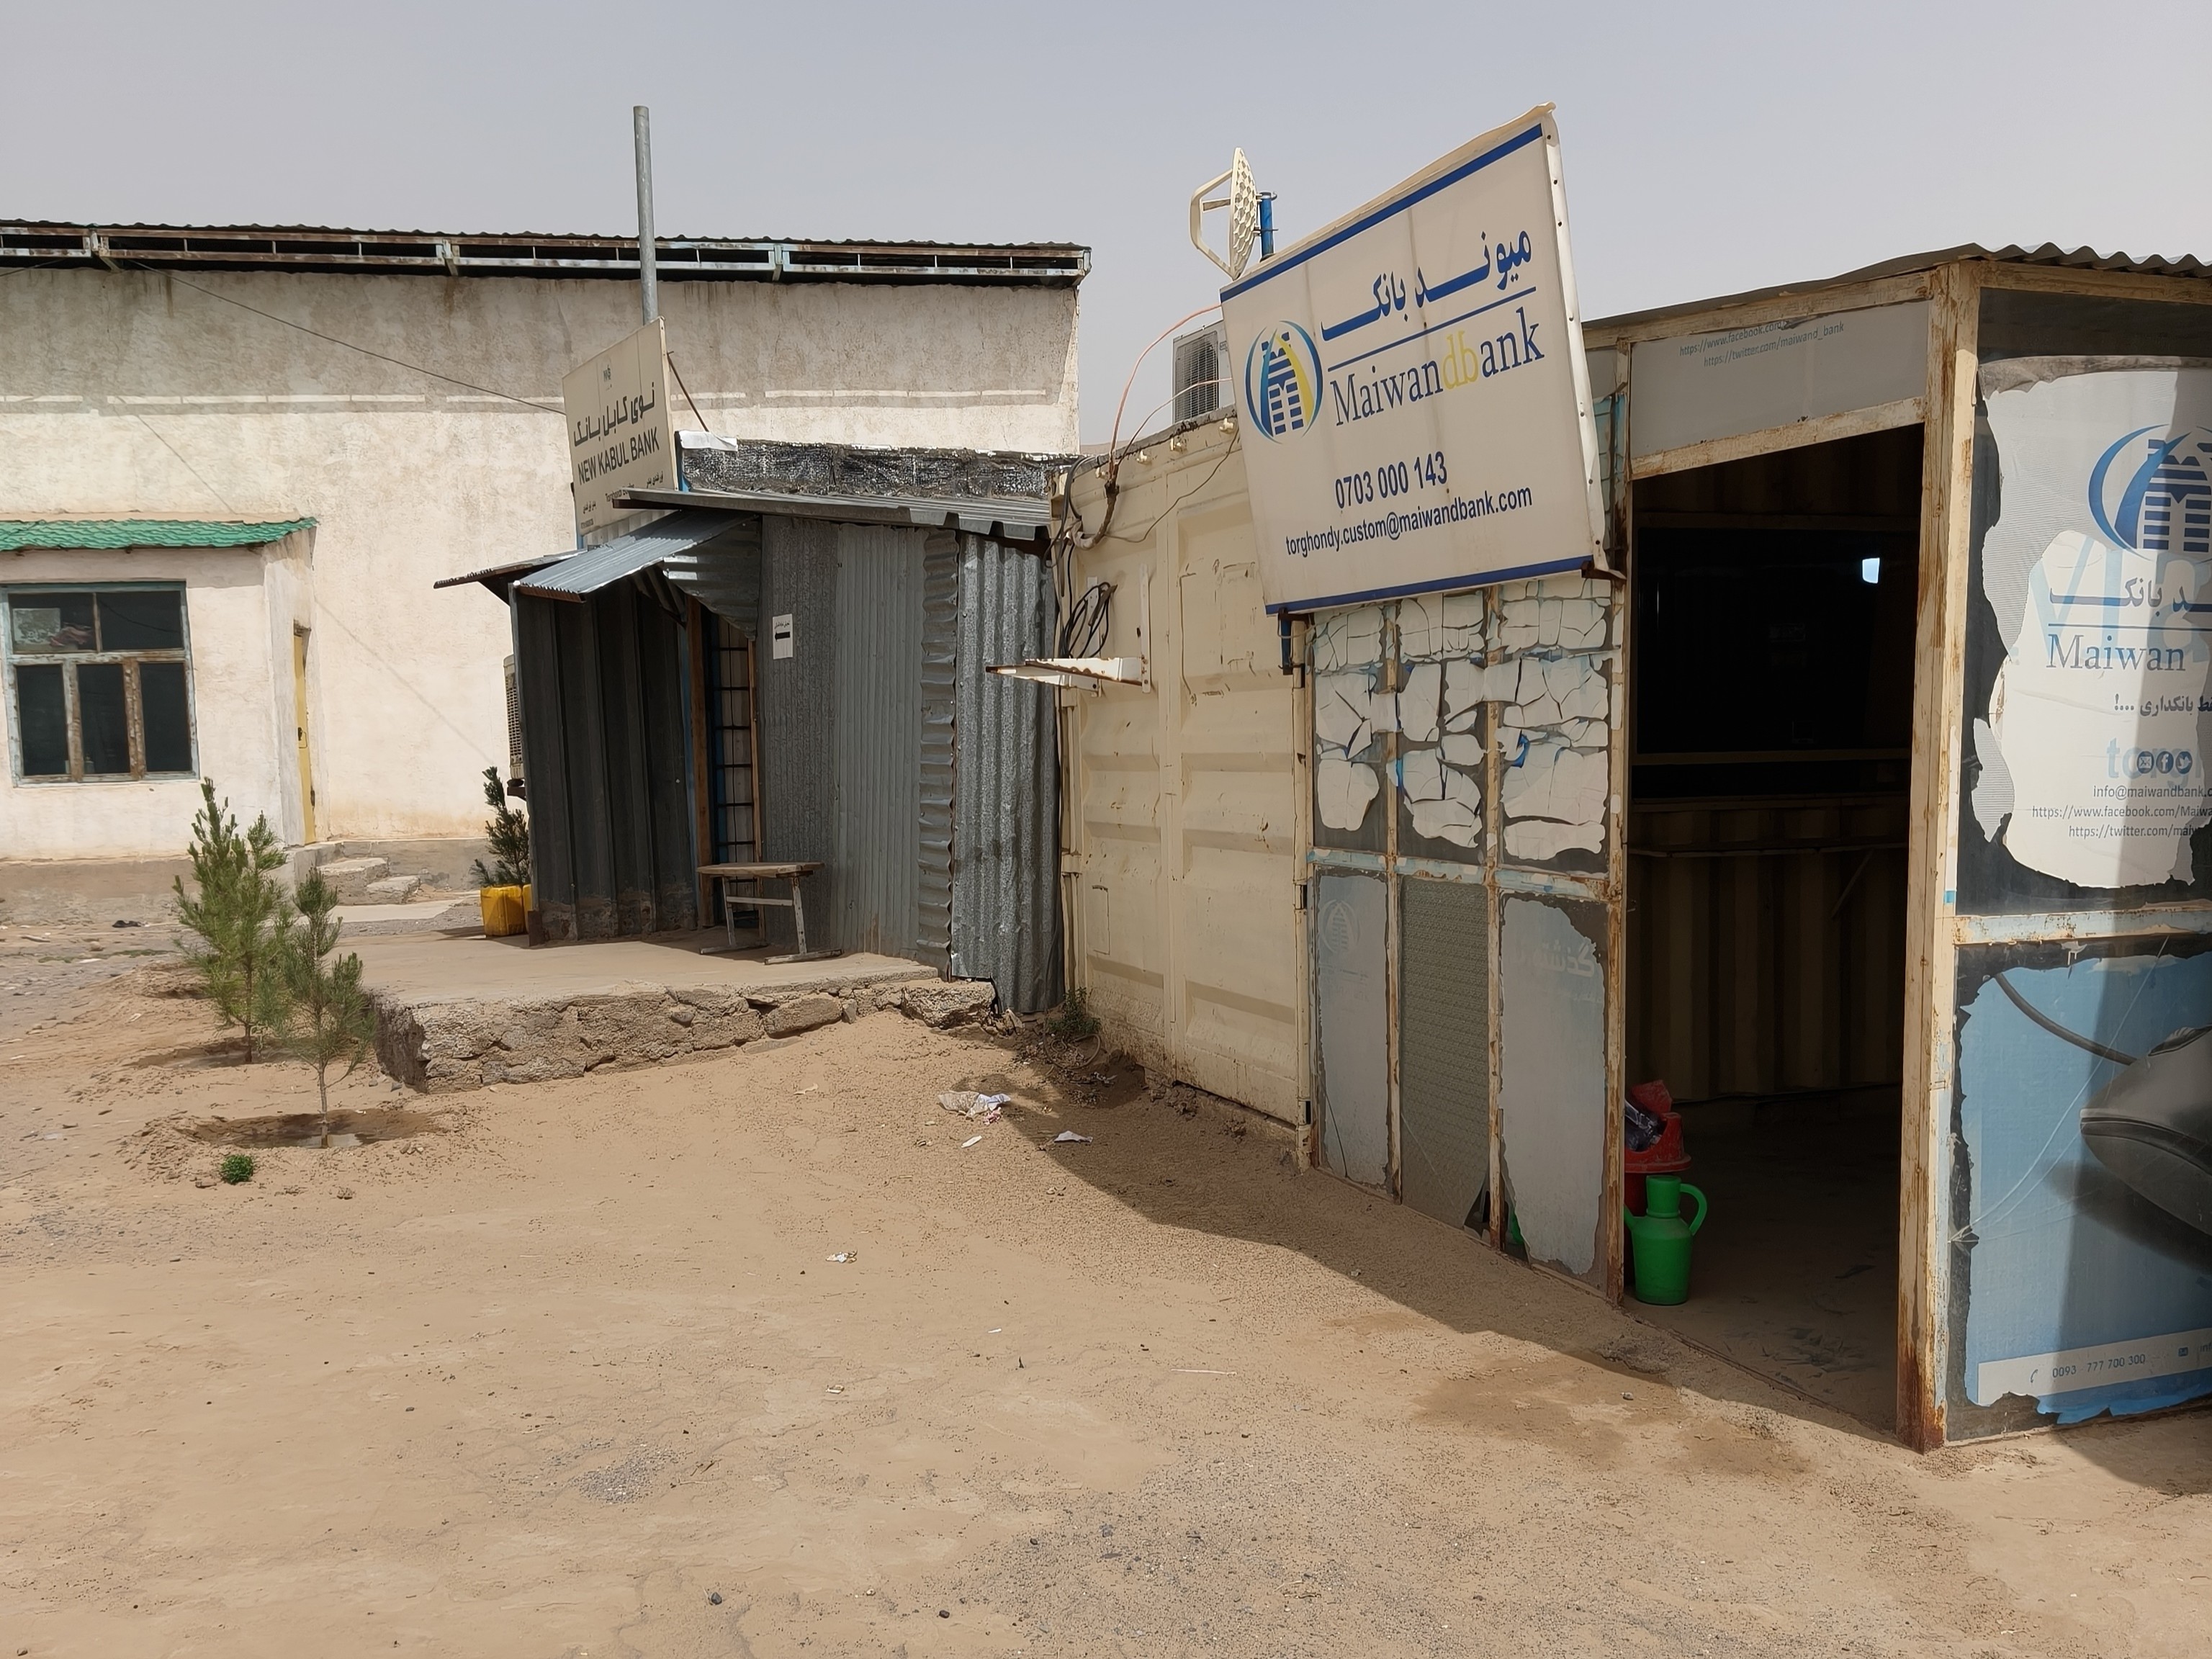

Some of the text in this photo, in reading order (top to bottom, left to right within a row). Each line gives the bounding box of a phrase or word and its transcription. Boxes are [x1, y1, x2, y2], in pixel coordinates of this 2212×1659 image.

[1321, 230, 1532, 341] میوند بانک
[577, 426, 660, 485] NEW KABUL BANK
[1335, 450, 1449, 510] 0703 000 143
[1285, 485, 1533, 558] torghondy.custom@maiwandbank.com
[2052, 1364, 2077, 1378] 0093
[2087, 1360, 2104, 1373] 777
[2108, 1357, 2125, 1369] 700
[2128, 1354, 2146, 1365] 300
